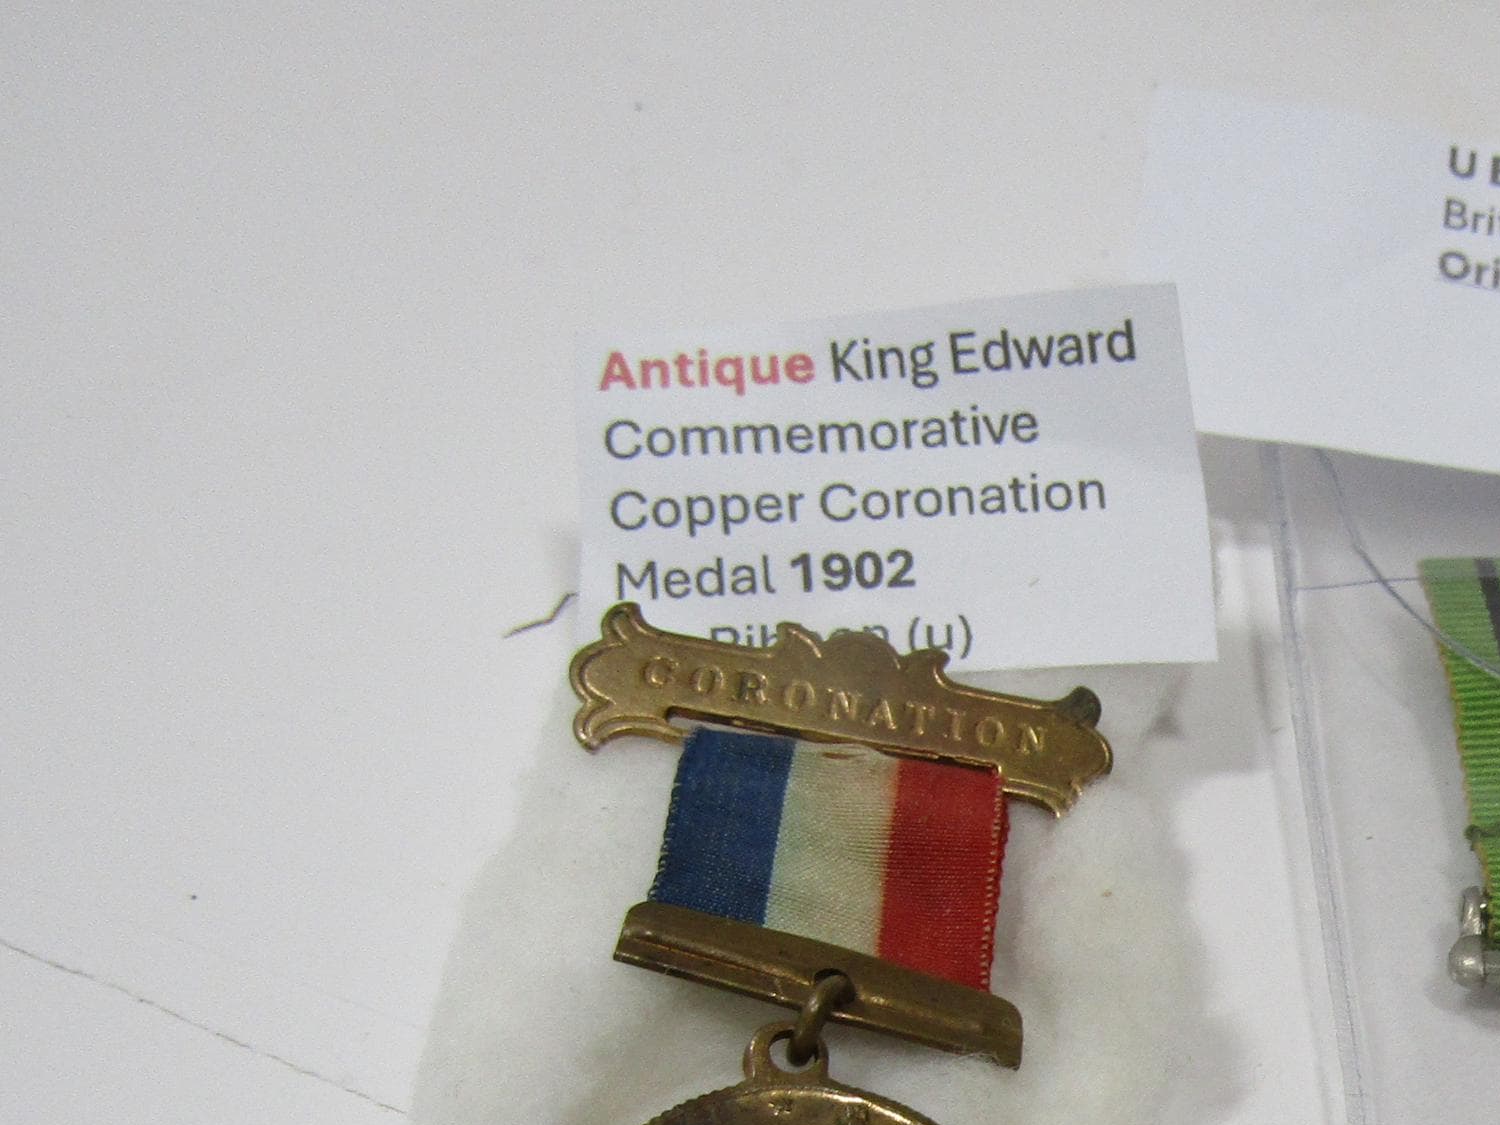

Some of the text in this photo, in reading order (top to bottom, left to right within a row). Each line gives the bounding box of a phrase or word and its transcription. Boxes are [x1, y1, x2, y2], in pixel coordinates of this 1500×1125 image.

[1449, 146, 1477, 179] U
[599, 318, 1136, 395] Antique King Edward
[603, 404, 1039, 460] Commemorative
[609, 473, 1106, 537] Copper Coronation
[615, 548, 916, 601] Medal 1902
[909, 615, 973, 661] (u)
[643, 656, 1049, 757] CORONATION
